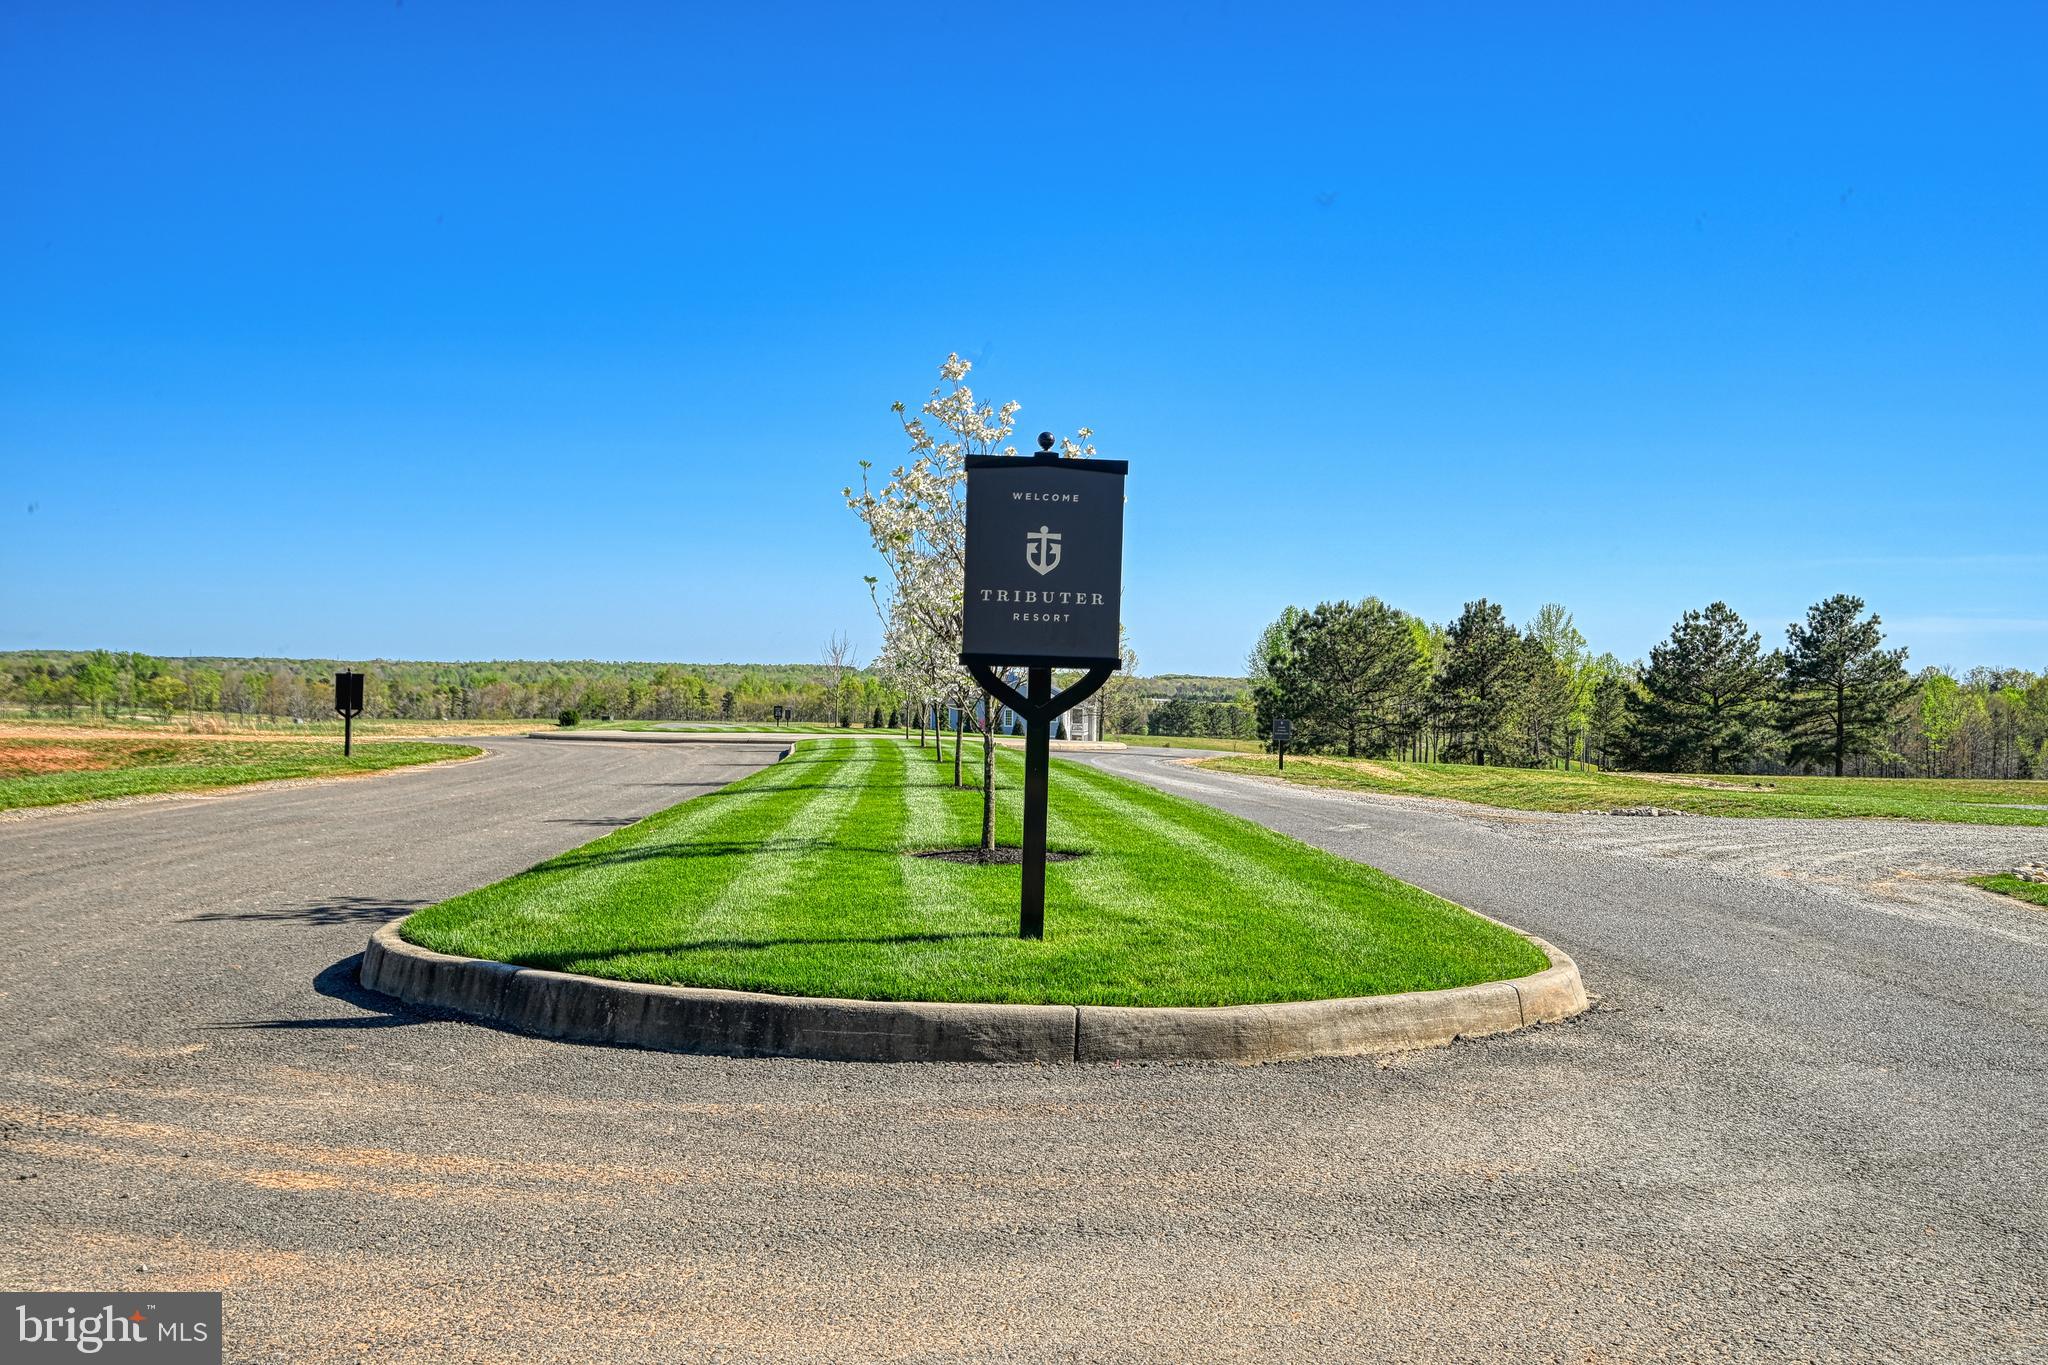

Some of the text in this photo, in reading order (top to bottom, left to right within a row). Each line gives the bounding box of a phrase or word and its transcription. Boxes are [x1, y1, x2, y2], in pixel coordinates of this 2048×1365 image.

[1012, 492, 1080, 503] WELCOME
[980, 588, 1105, 606] TRIBUTER
[1012, 612, 1071, 623] RESORT
